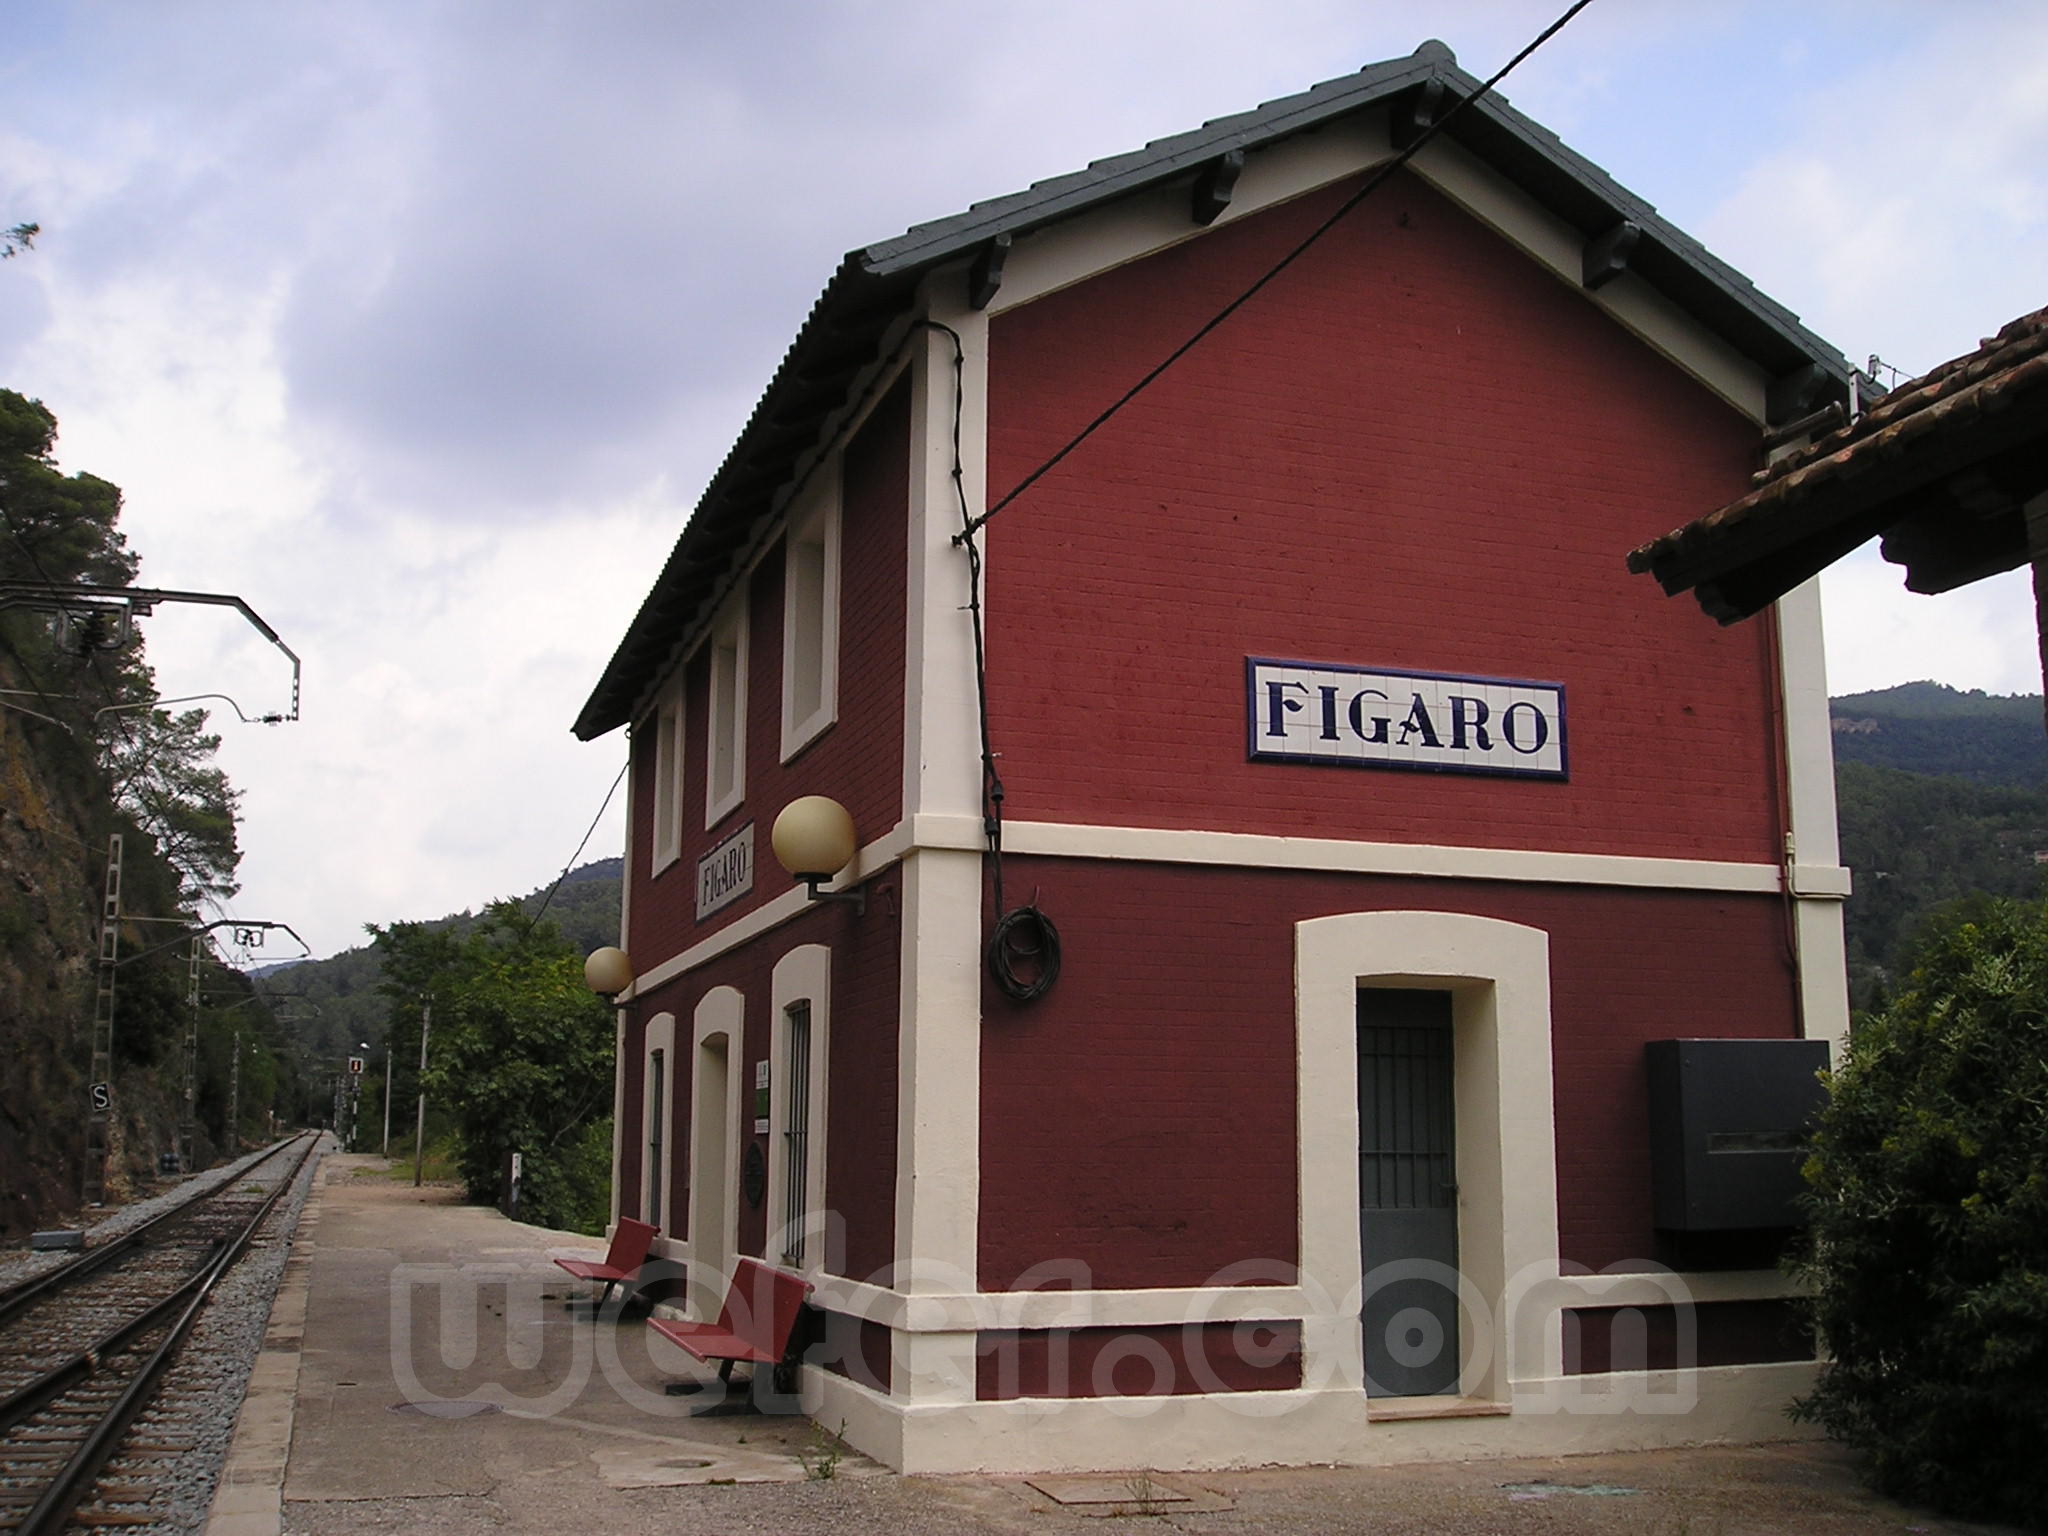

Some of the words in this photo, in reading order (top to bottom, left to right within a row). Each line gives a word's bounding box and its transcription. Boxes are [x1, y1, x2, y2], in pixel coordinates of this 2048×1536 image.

[1265, 680, 1549, 754] FIGARO
[703, 841, 746, 906] FIGARO
[93, 1086, 108, 1108] S
